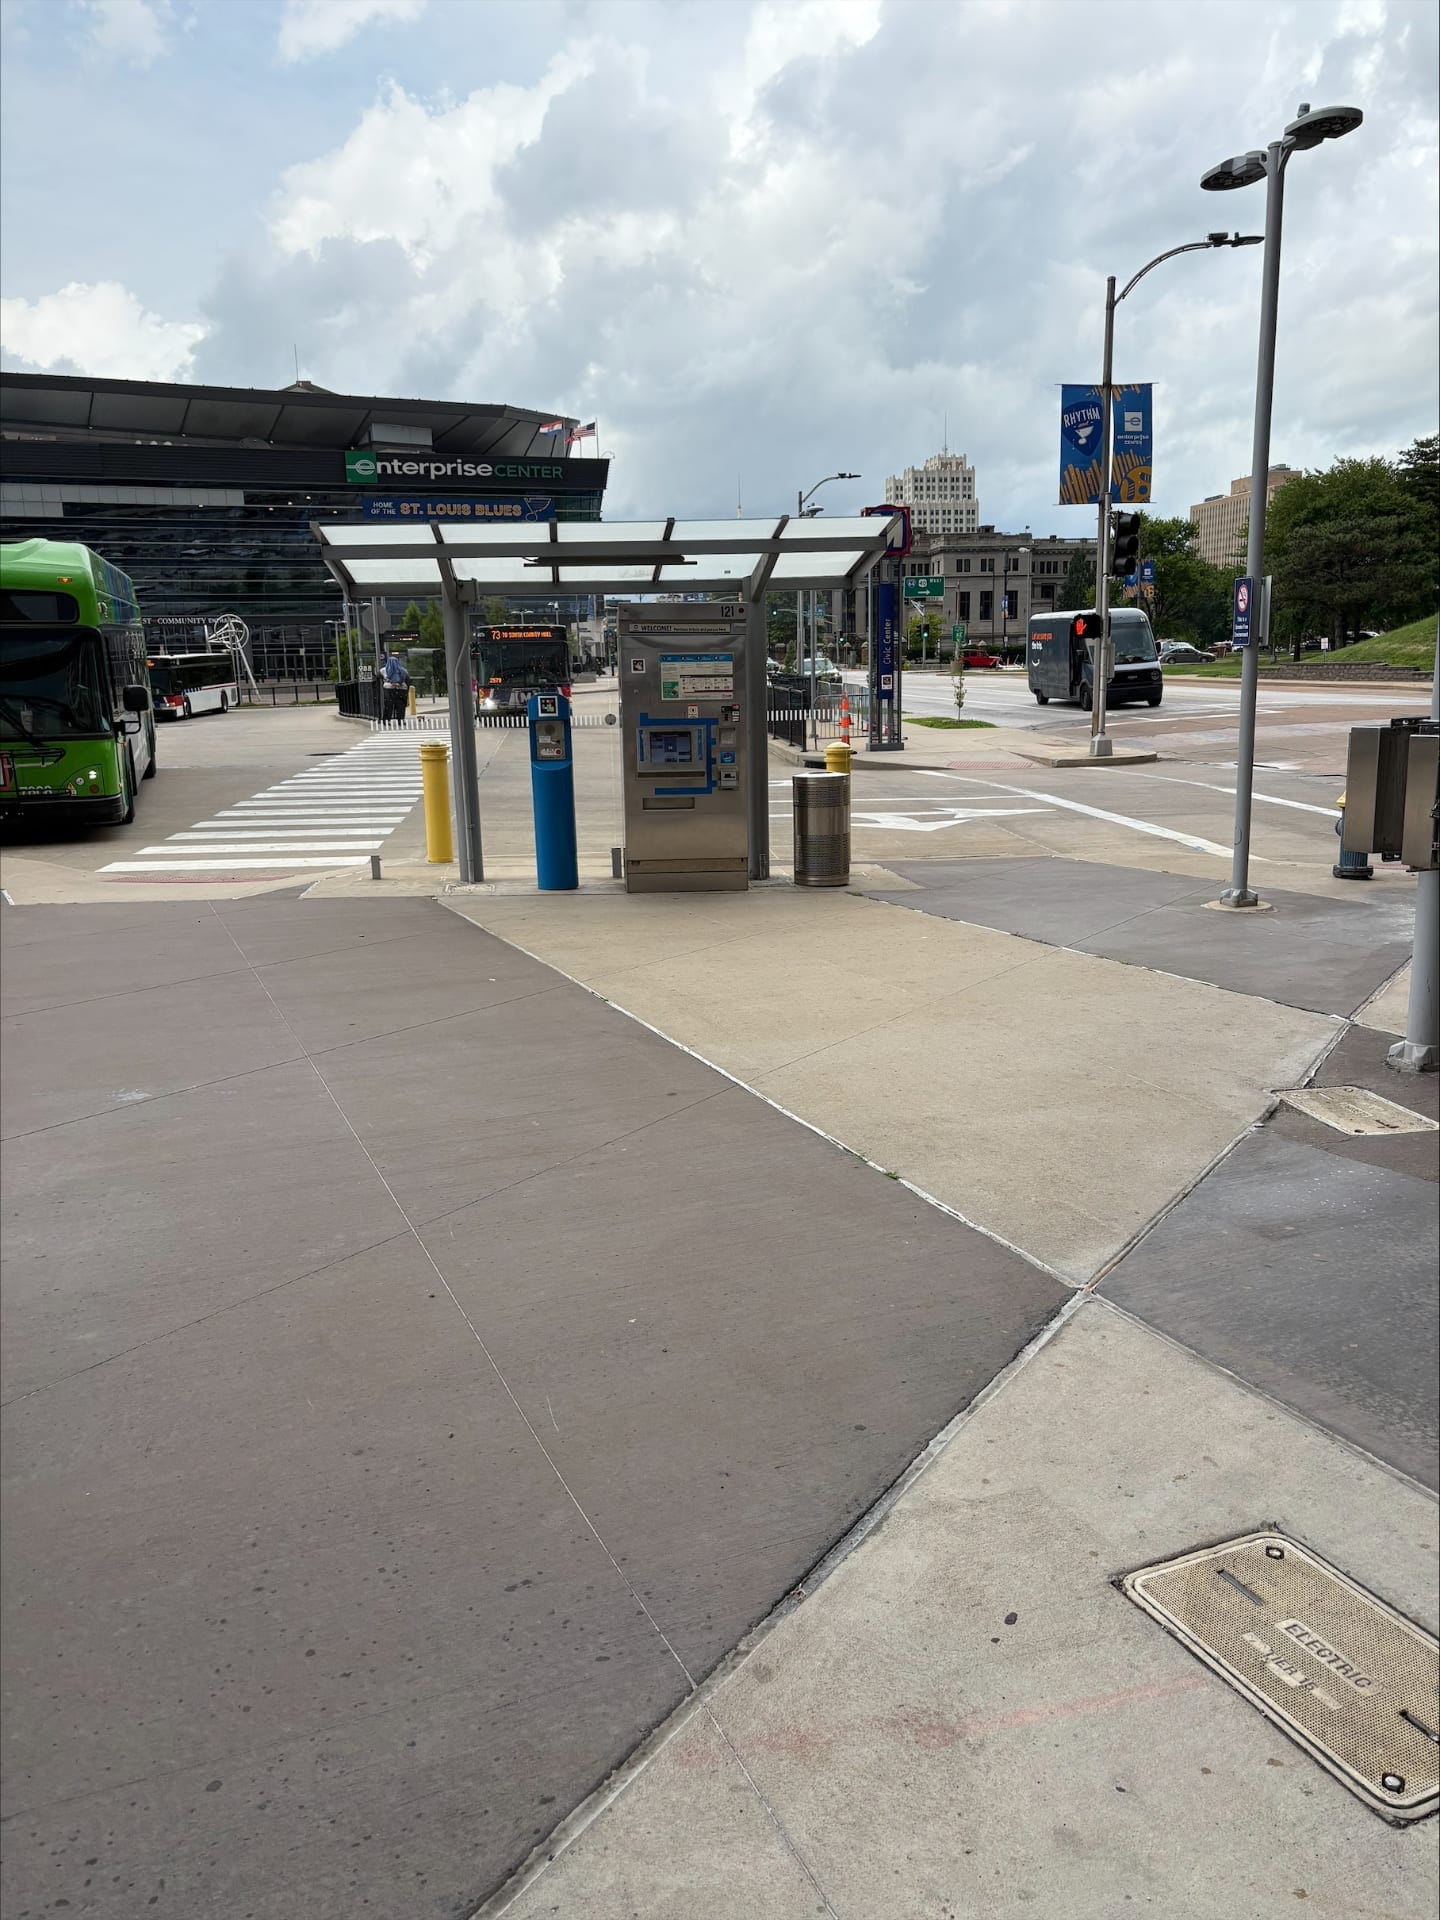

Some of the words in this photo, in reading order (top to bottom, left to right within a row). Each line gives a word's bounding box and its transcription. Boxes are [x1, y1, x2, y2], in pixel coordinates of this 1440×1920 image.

[1063, 407, 1101, 428] RHYTHM
[354, 458, 493, 479] enterprise
[493, 464, 564, 479] CENTER
[400, 503, 424, 515] ST.
[427, 503, 472, 516] LOUIS
[474, 503, 523, 517] BLUES
[157, 617, 207, 625] COMMUNITY
[720, 605, 735, 618] 121
[491, 630, 501, 640] 73
[882, 618, 893, 645] Center
[882, 646, 893, 665] Civic
[1284, 1623, 1372, 1688] ELECTRIC
